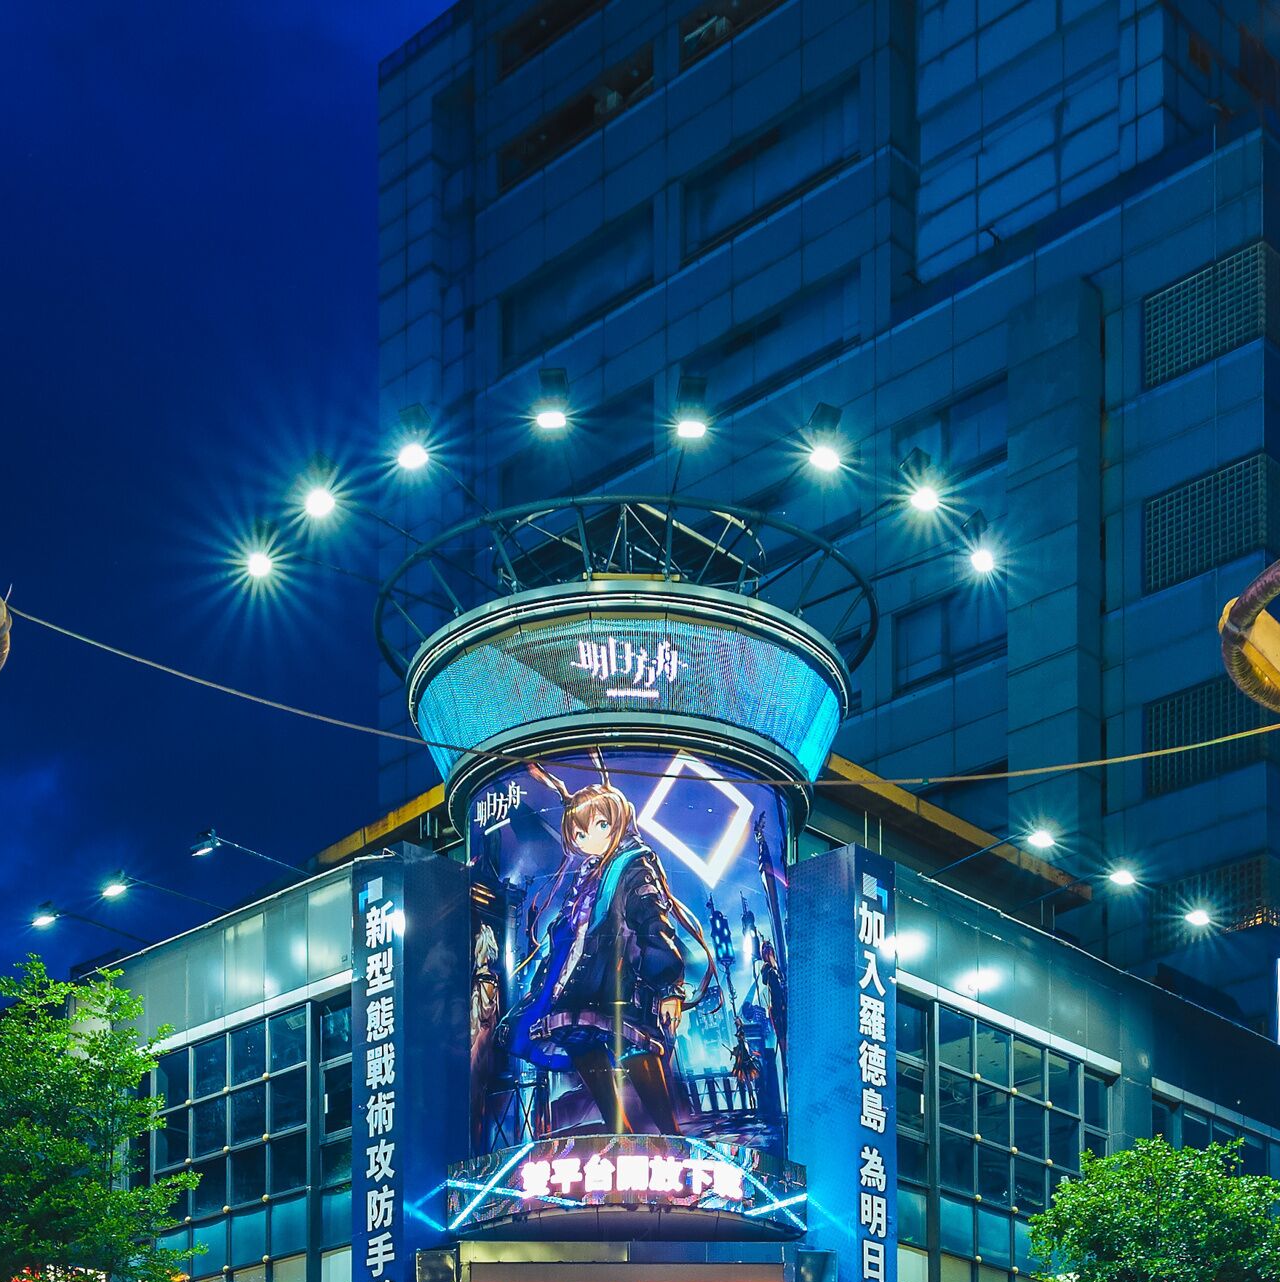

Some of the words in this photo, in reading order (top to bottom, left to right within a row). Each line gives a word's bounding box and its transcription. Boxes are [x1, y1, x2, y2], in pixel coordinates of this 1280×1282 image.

[571, 640, 688, 687] 明日方舟
[474, 780, 527, 828] 明日方舟
[858, 902, 889, 1134] 加入羅德島
